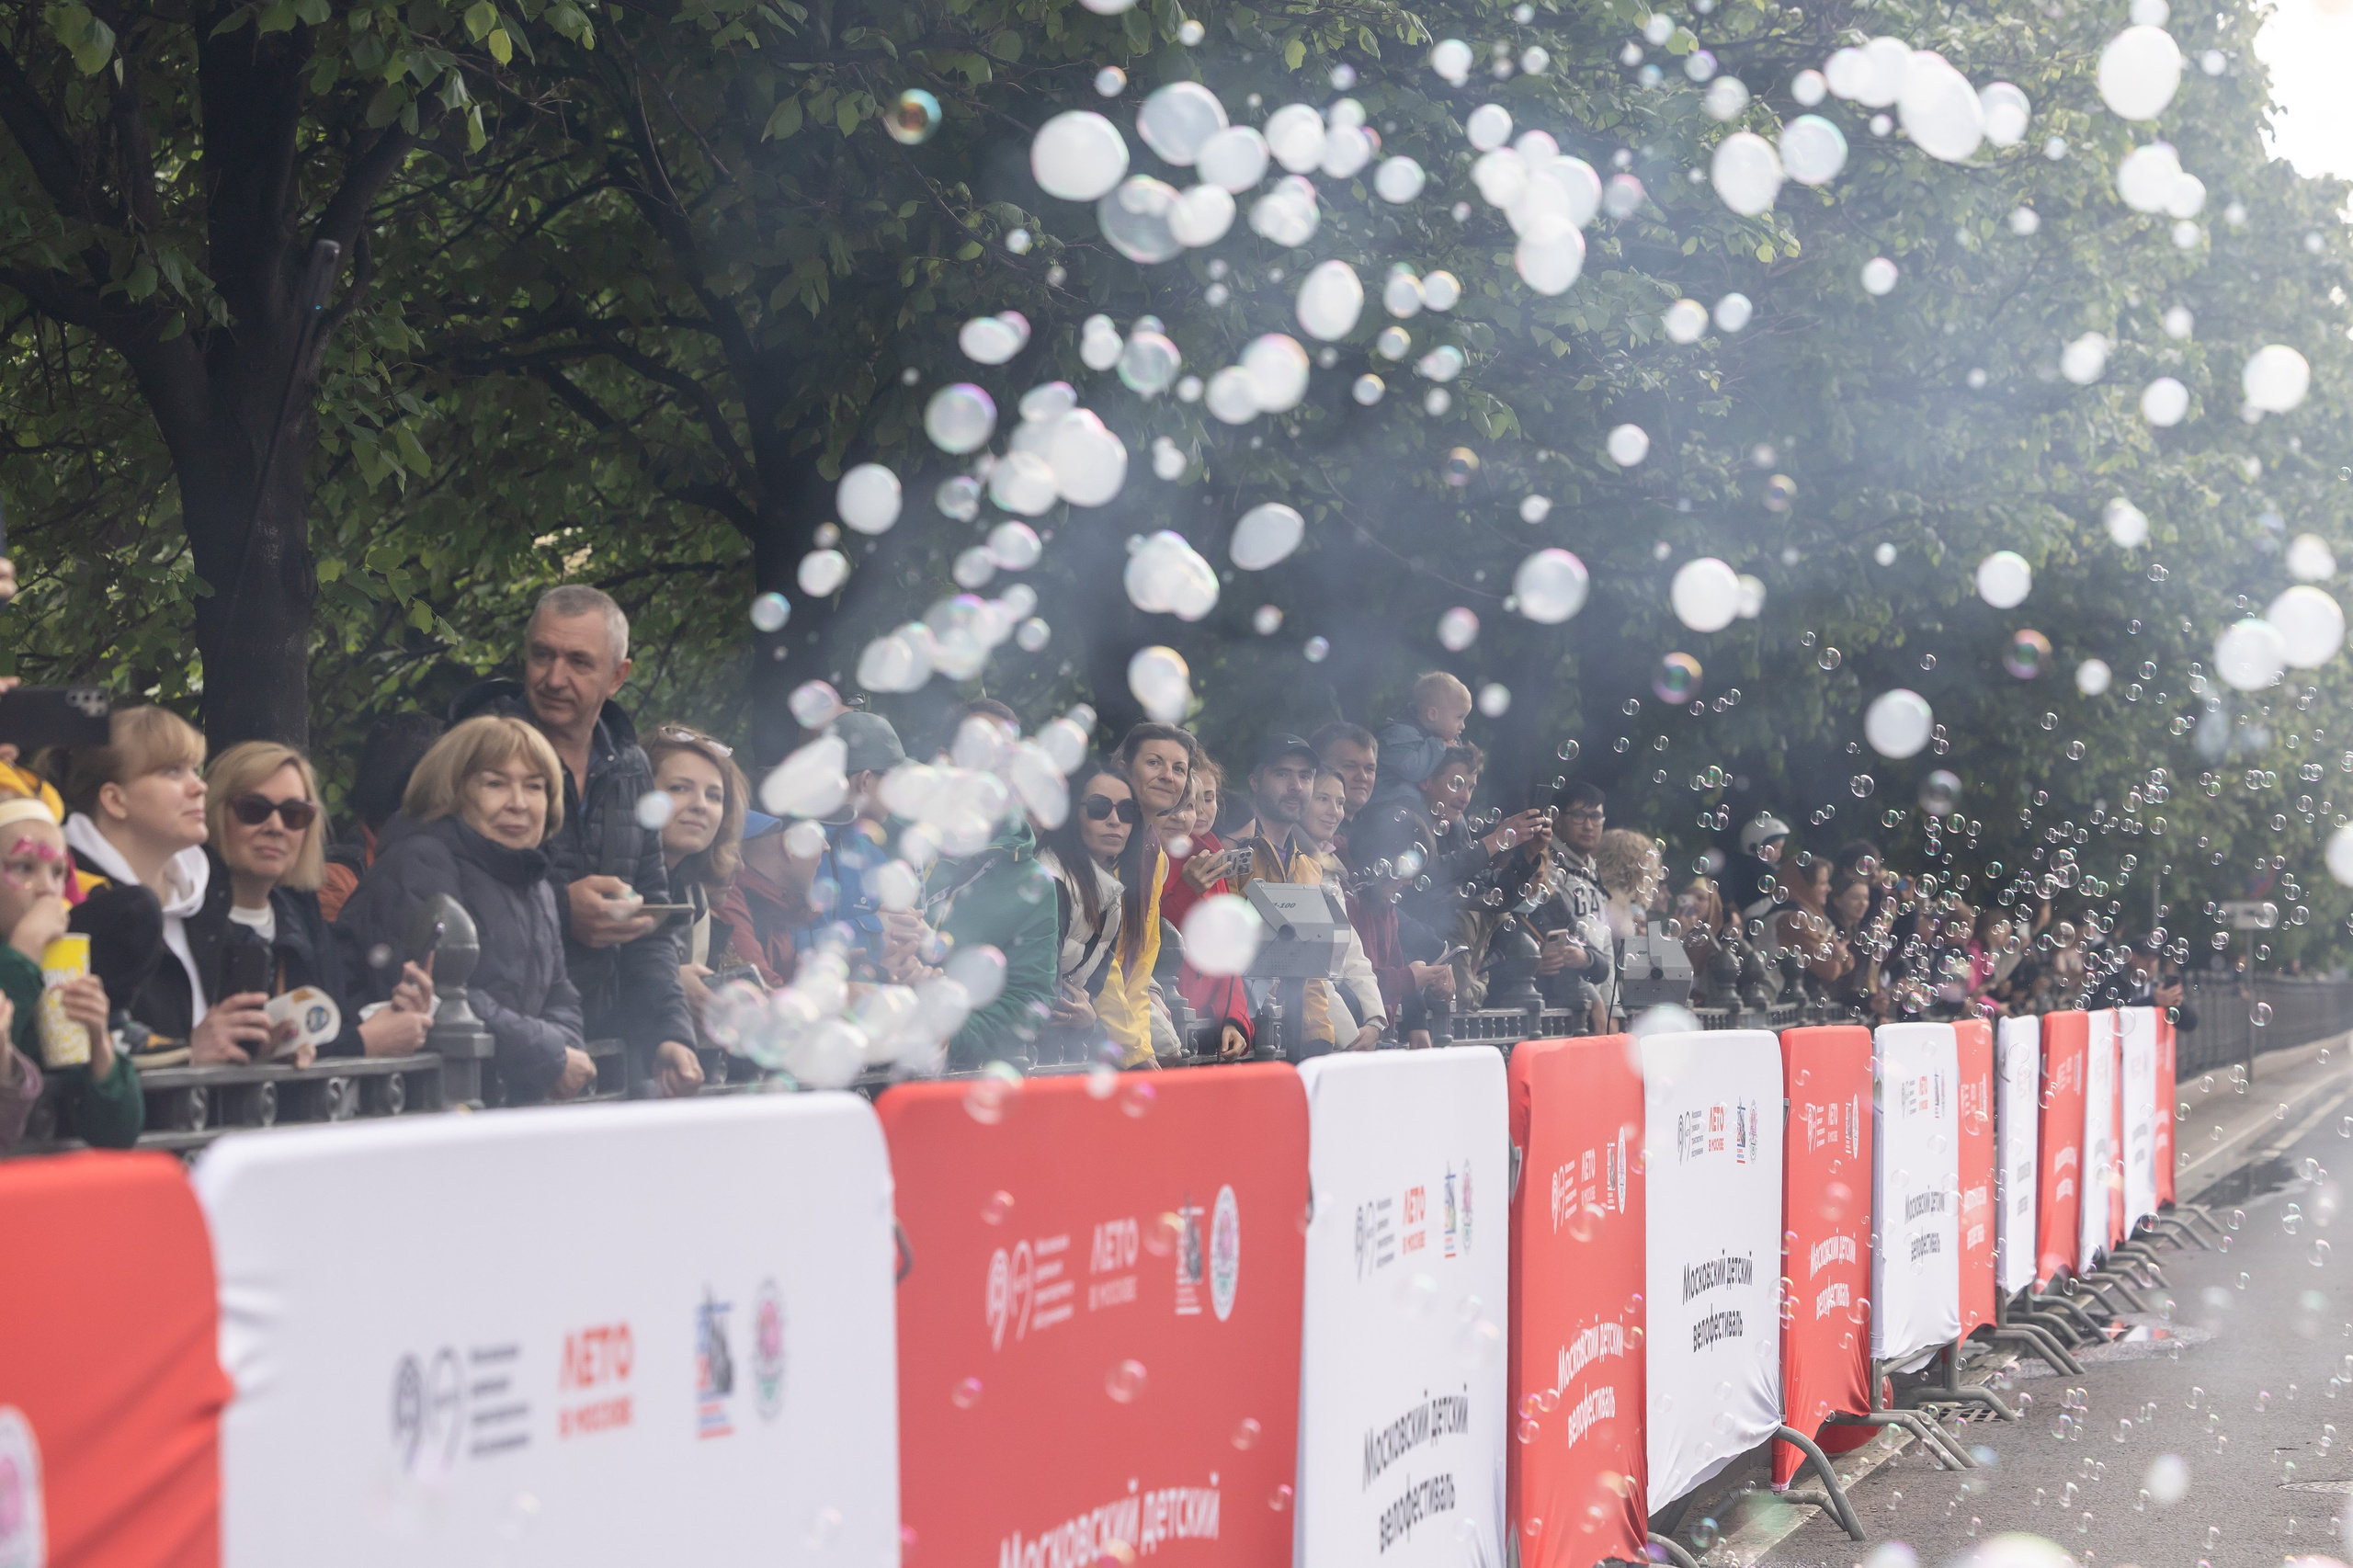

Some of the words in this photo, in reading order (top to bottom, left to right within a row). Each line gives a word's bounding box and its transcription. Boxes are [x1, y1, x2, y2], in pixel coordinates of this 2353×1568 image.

[1708, 1106, 1724, 1132] ЛЕТО
[1403, 1184, 1426, 1226] ЛЕТО
[1089, 1216, 1139, 1275] ЛЕТО
[1682, 1248, 1726, 1305] Московский
[1726, 1250, 1753, 1290] детский
[557, 1320, 635, 1392] ЛЕТО
[1558, 1313, 1599, 1398] Московский
[1599, 1313, 1624, 1363] детский
[1693, 1302, 1743, 1353] велофестиваль
[1361, 1389, 1430, 1494] Московский
[1430, 1381, 1468, 1448] детский
[1568, 1382, 1616, 1449] велофестиваль
[1140, 1470, 1221, 1556] детский
[1379, 1473, 1456, 1555] велофестиваль
